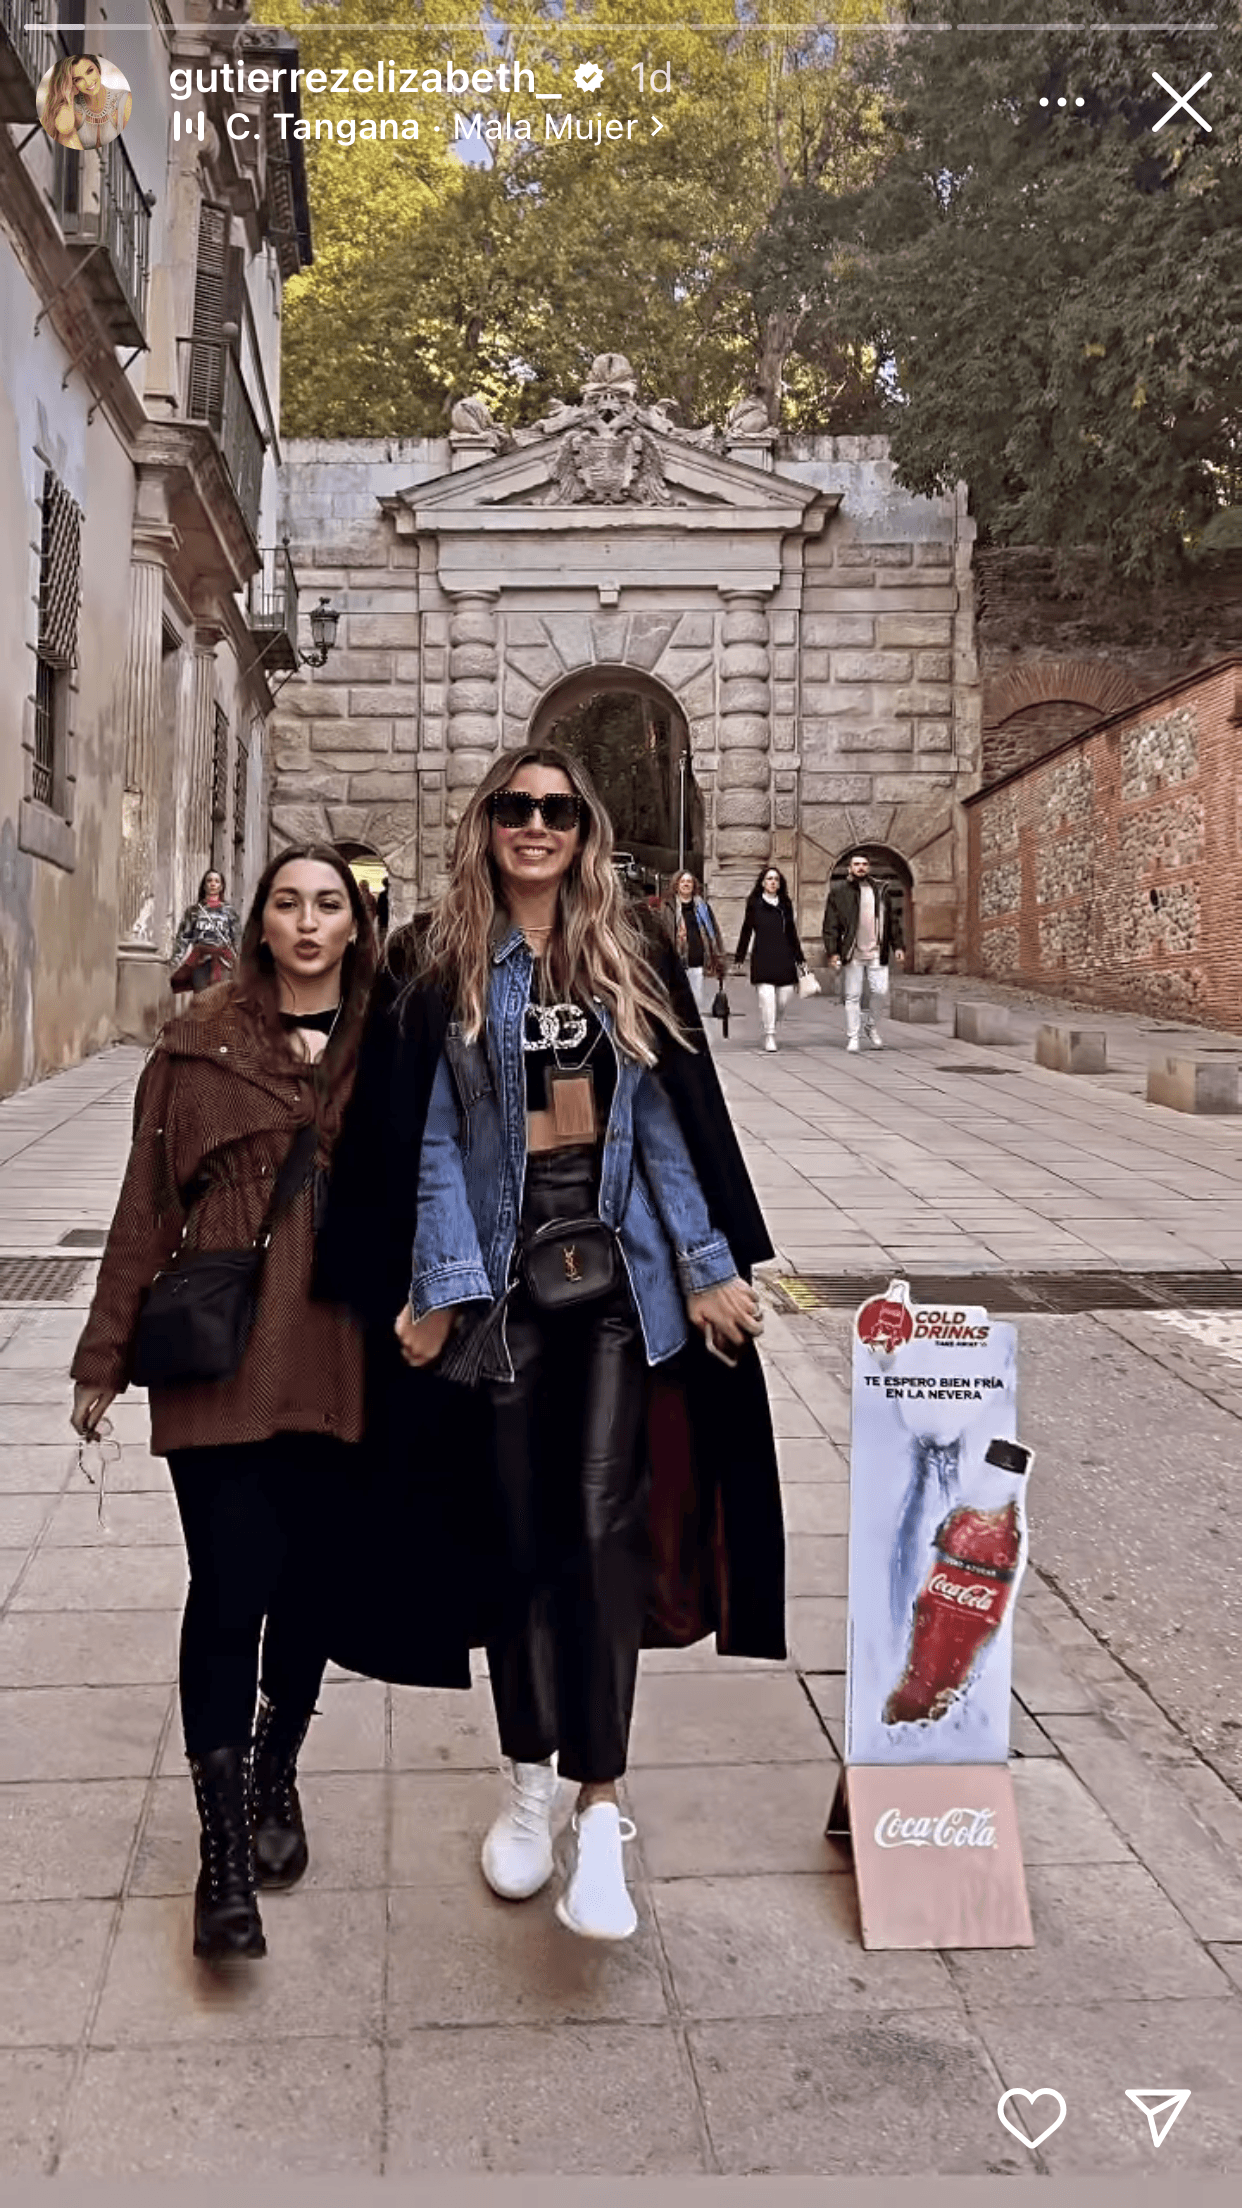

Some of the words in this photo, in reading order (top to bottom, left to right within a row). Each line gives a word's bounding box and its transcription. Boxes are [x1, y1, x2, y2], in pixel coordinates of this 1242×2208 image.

[915, 1311, 966, 1324] COLD
[914, 1325, 990, 1339] DRINKS
[864, 1376, 880, 1386] TE
[884, 1376, 936, 1388] ESPERO
[939, 1378, 970, 1388] BIEN
[974, 1376, 1004, 1389] FRÍA
[886, 1388, 903, 1399] EN
[907, 1389, 925, 1399] LA
[928, 1389, 982, 1400] NEVERA
